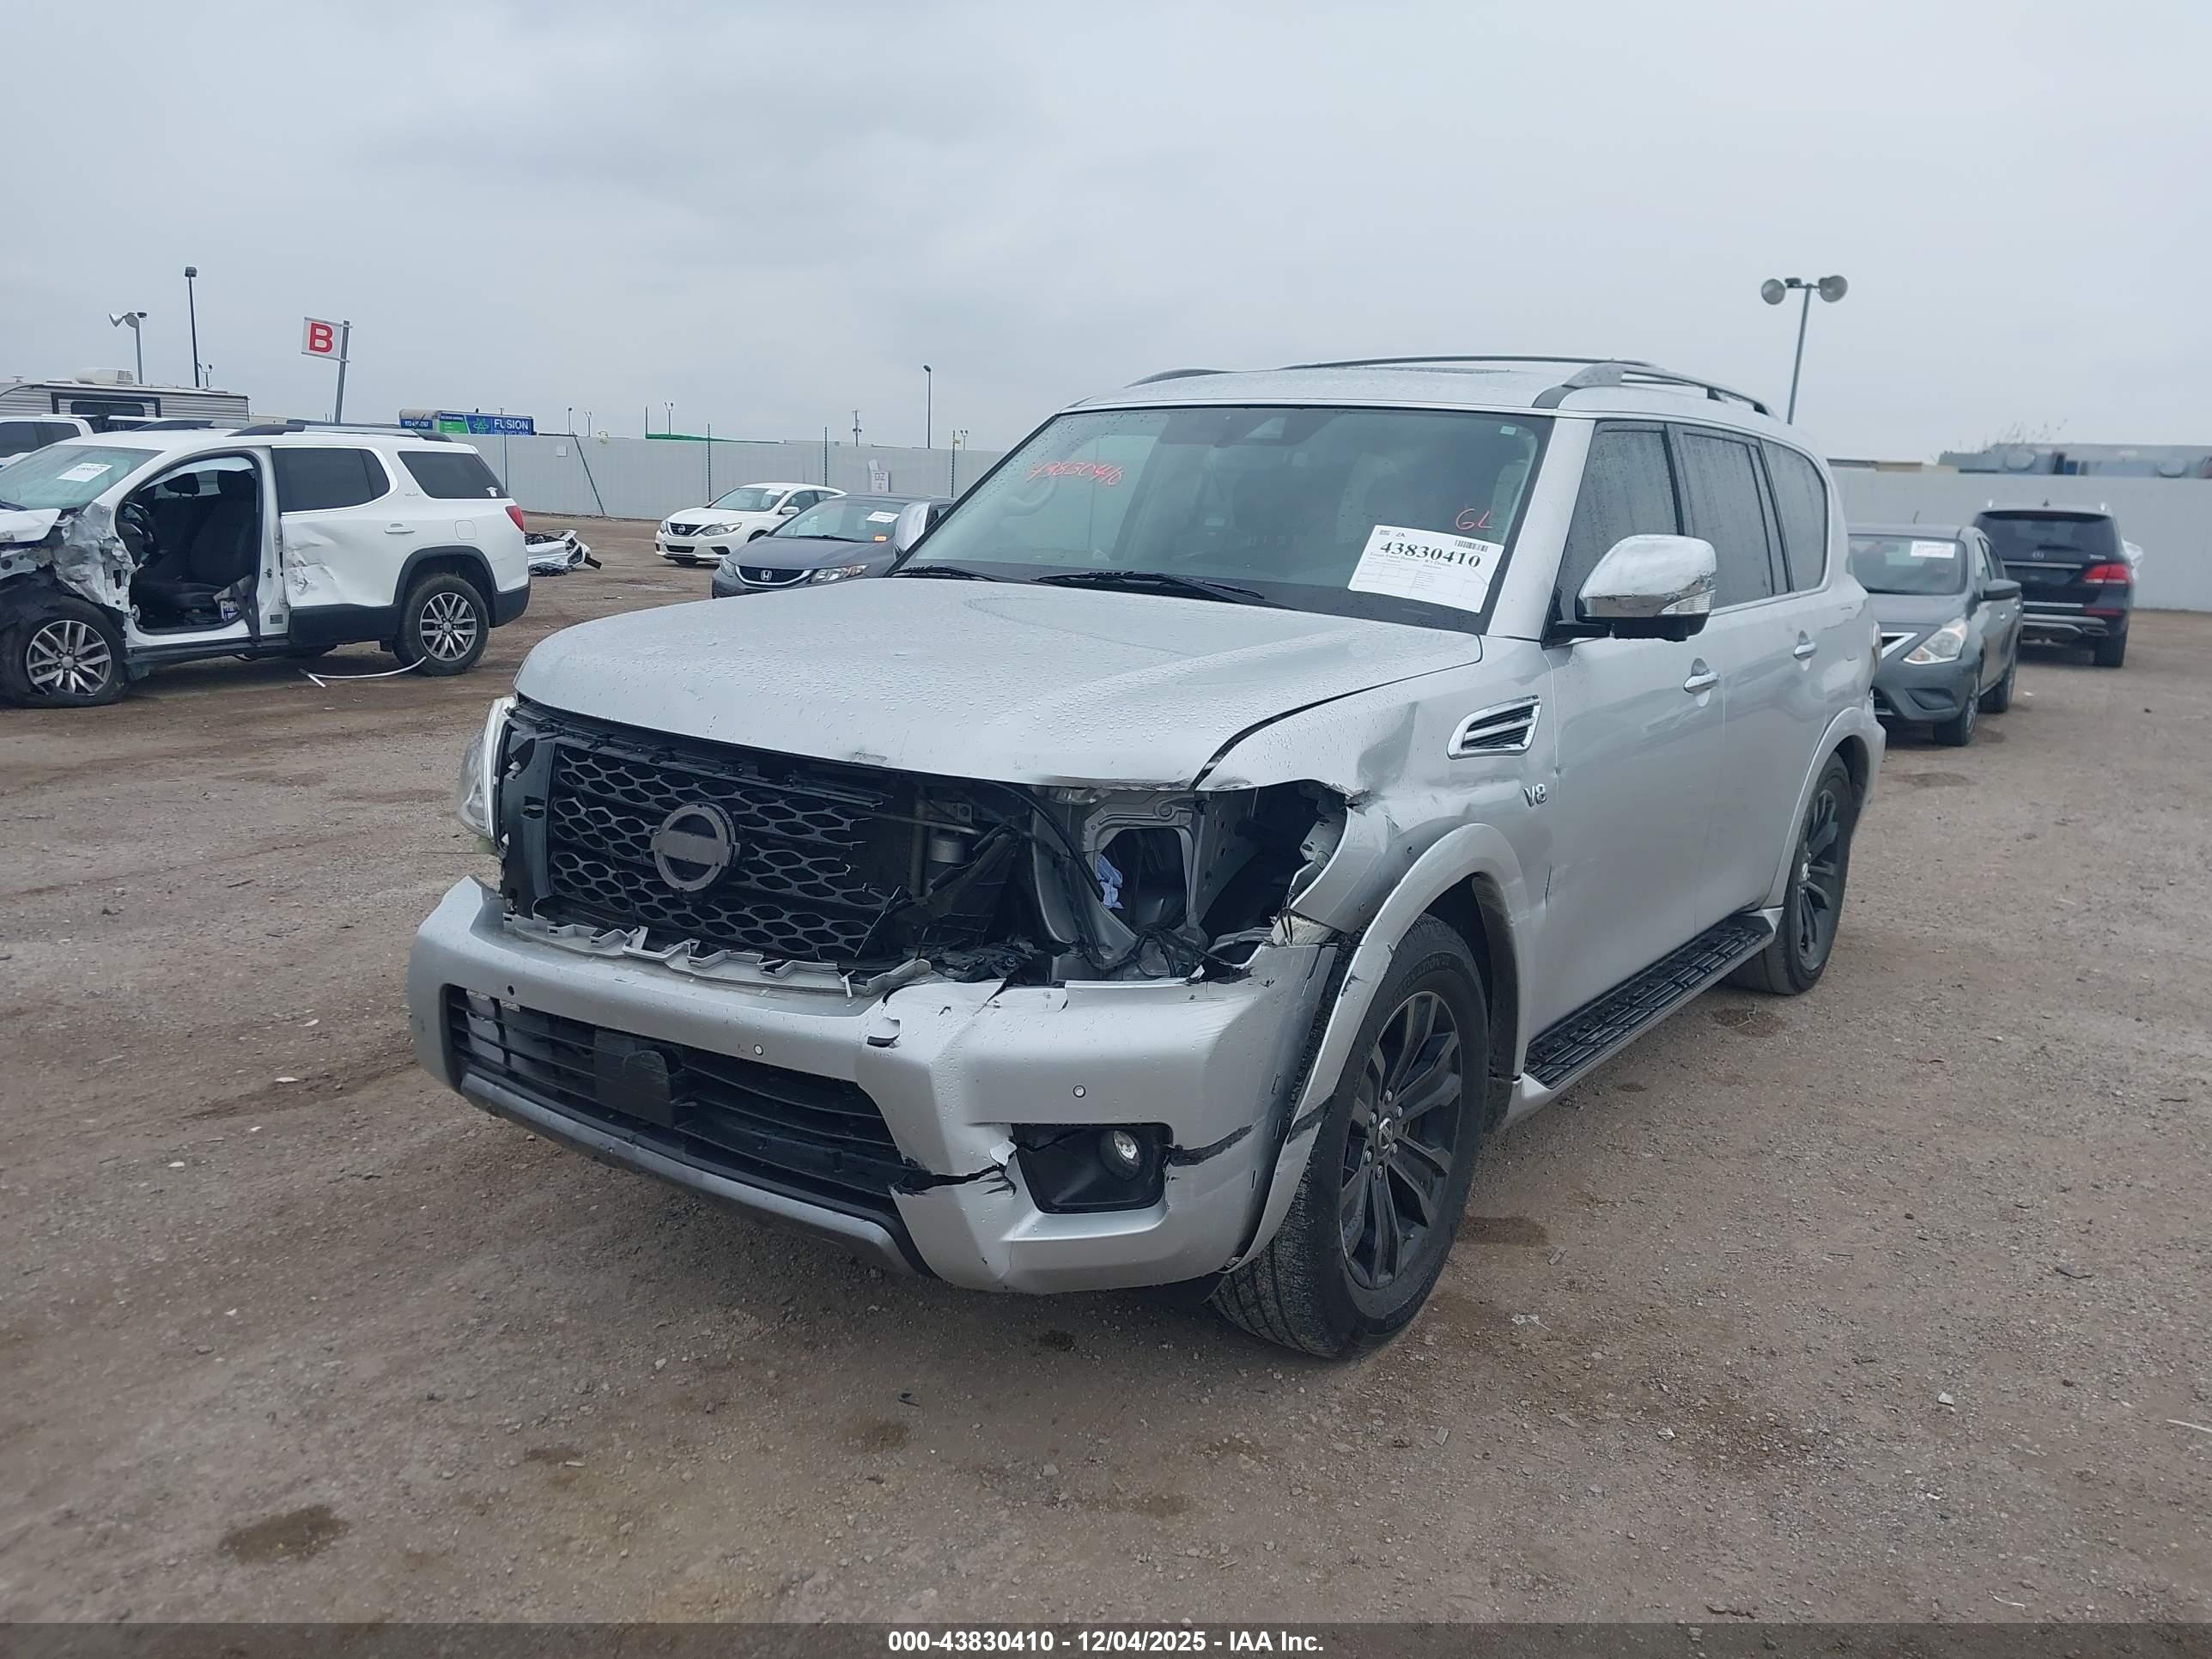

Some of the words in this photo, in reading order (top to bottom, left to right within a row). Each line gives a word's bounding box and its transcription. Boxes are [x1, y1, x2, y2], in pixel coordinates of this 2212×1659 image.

[309, 322, 333, 353] B
[494, 418, 529, 430] FUSION
[1380, 541, 1481, 568] 43830410
[1522, 783, 1547, 807] V8
